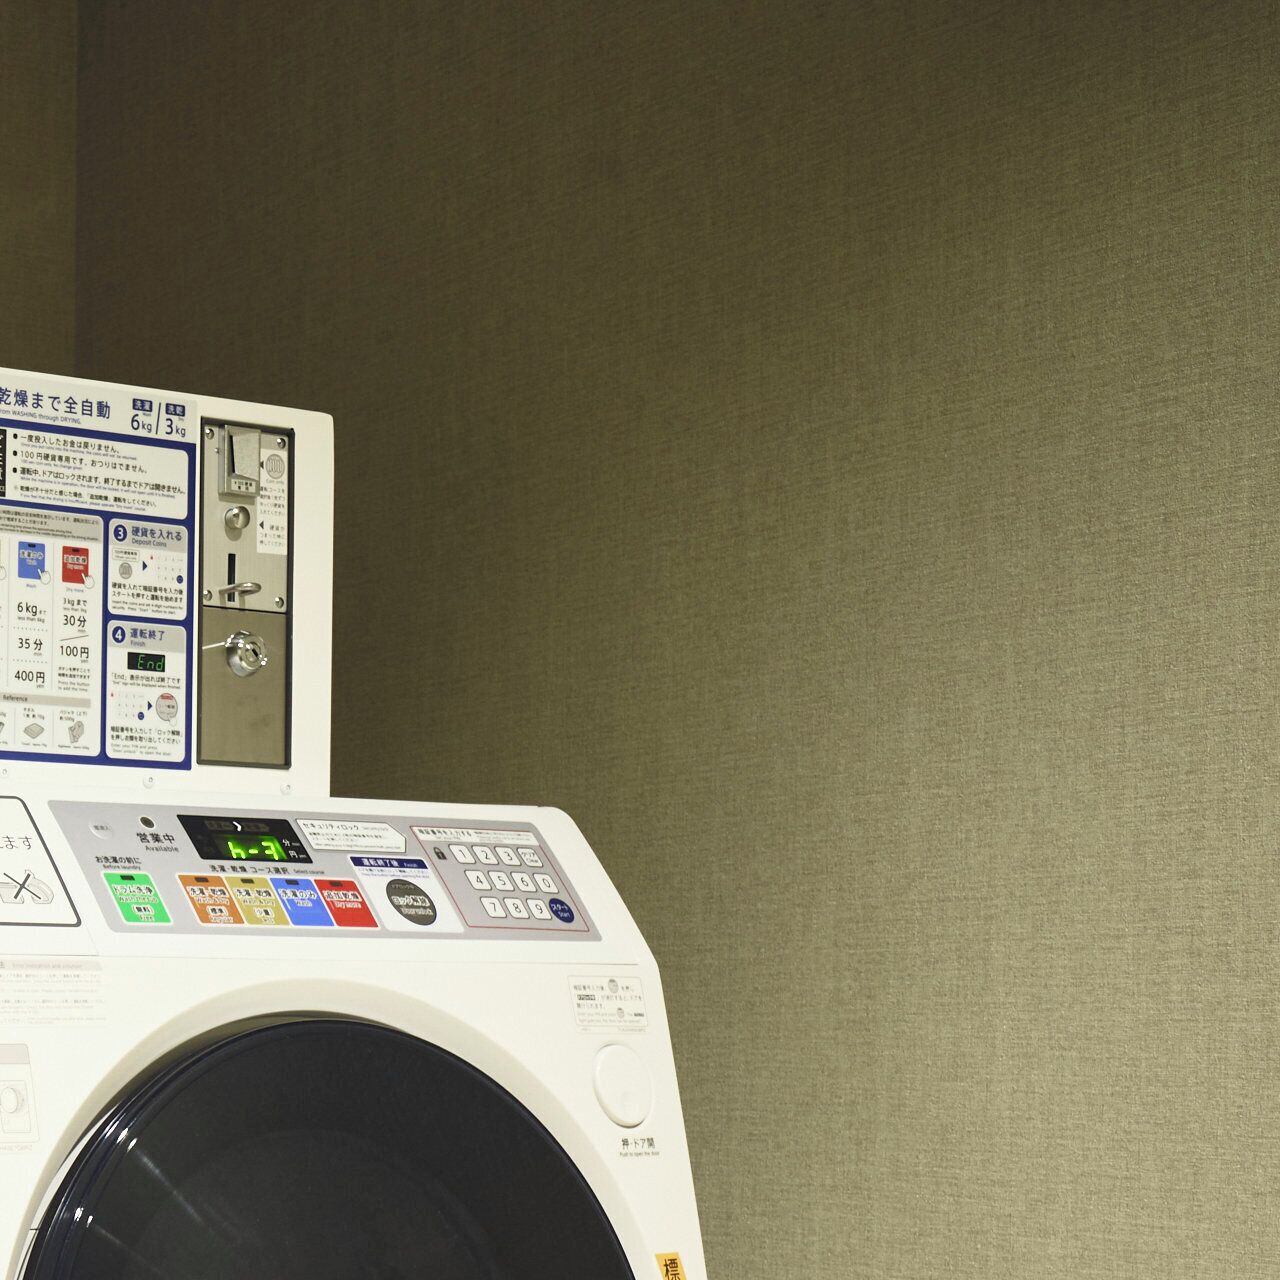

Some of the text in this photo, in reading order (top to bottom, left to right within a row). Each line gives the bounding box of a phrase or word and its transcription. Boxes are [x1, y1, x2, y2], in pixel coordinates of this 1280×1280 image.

[132, 526, 182, 540] 硬貨を入れる
[130, 627, 165, 639] 運転終了
[136, 832, 174, 844] 営業中
[145, 845, 179, 853] Available
